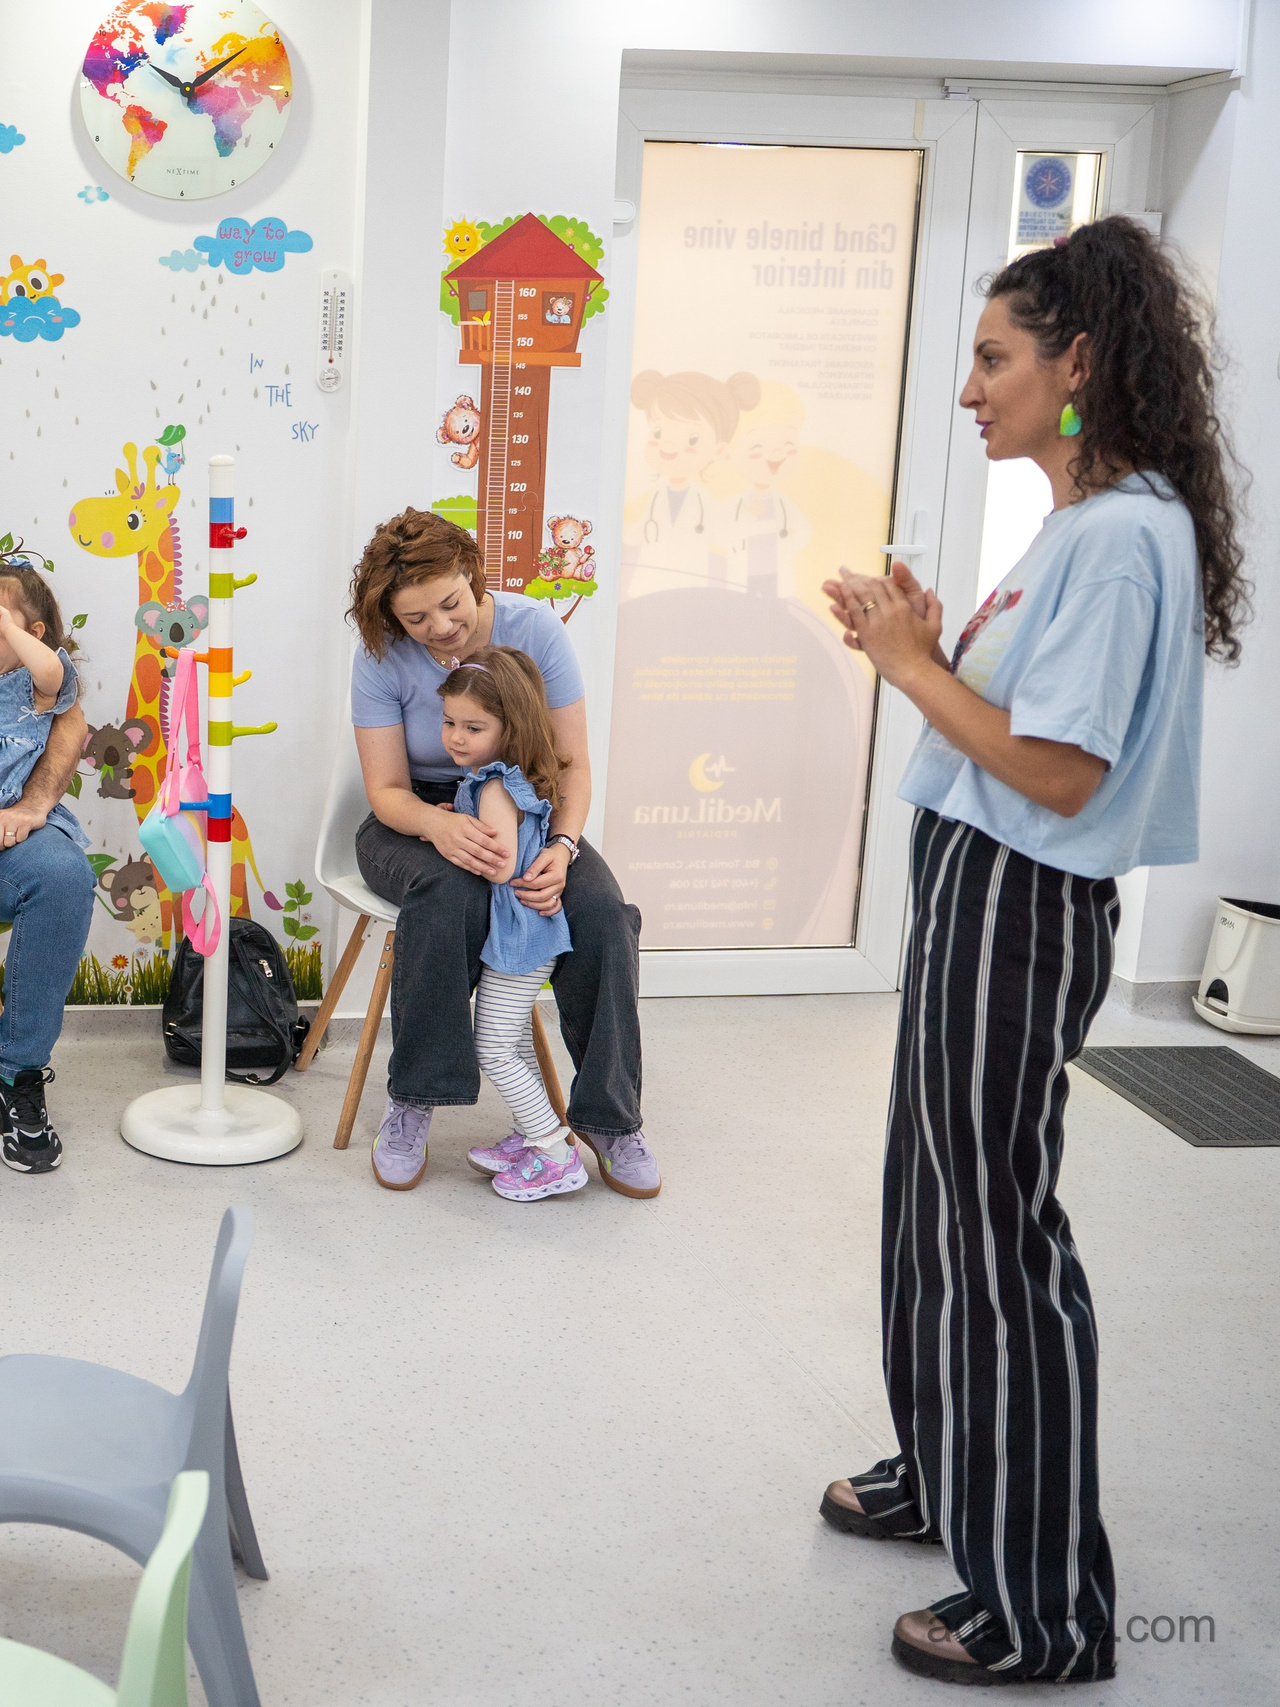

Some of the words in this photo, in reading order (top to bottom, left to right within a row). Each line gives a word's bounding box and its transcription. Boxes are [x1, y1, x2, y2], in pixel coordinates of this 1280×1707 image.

[219, 226, 256, 244] way
[262, 223, 285, 240] to
[234, 250, 277, 267] grow
[518, 287, 536, 298] 160
[516, 337, 534, 347] 150
[250, 353, 264, 374] IN
[265, 383, 292, 407] THE
[514, 386, 532, 396] 140
[291, 421, 319, 443] SKY
[511, 434, 529, 444] 130
[509, 482, 527, 492] 120
[507, 530, 523, 540] 110
[505, 577, 523, 588] 100
